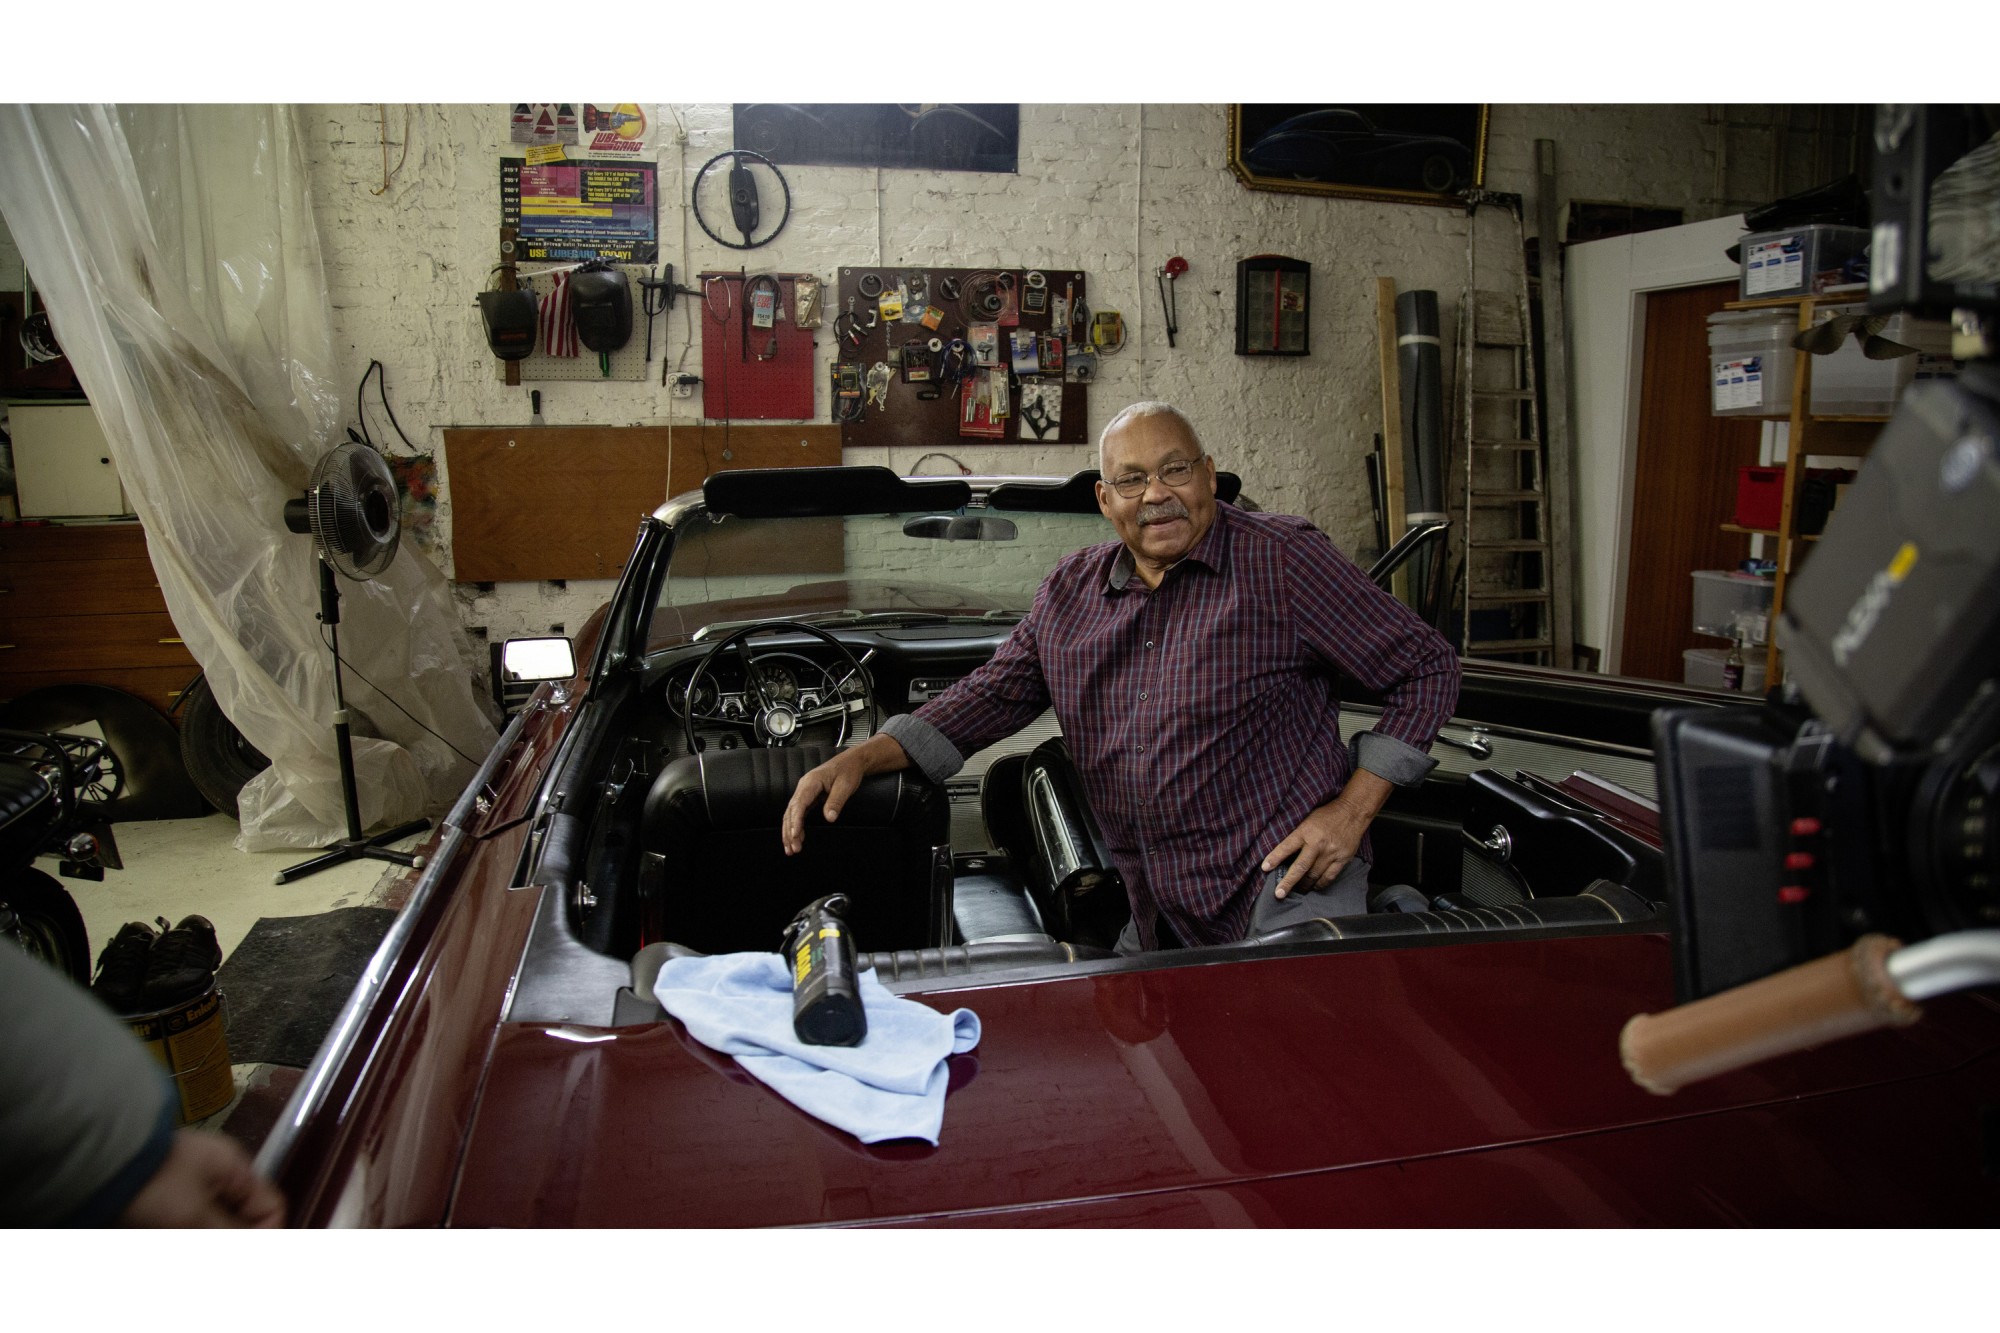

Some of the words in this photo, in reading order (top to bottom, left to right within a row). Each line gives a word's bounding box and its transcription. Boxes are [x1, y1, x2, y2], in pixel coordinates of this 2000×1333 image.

[589, 133, 619, 150] LUBE
[612, 141, 643, 151] GARD
[529, 248, 547, 257] USE
[550, 249, 596, 259] LUBEGARD
[599, 250, 631, 259] TODAY!
